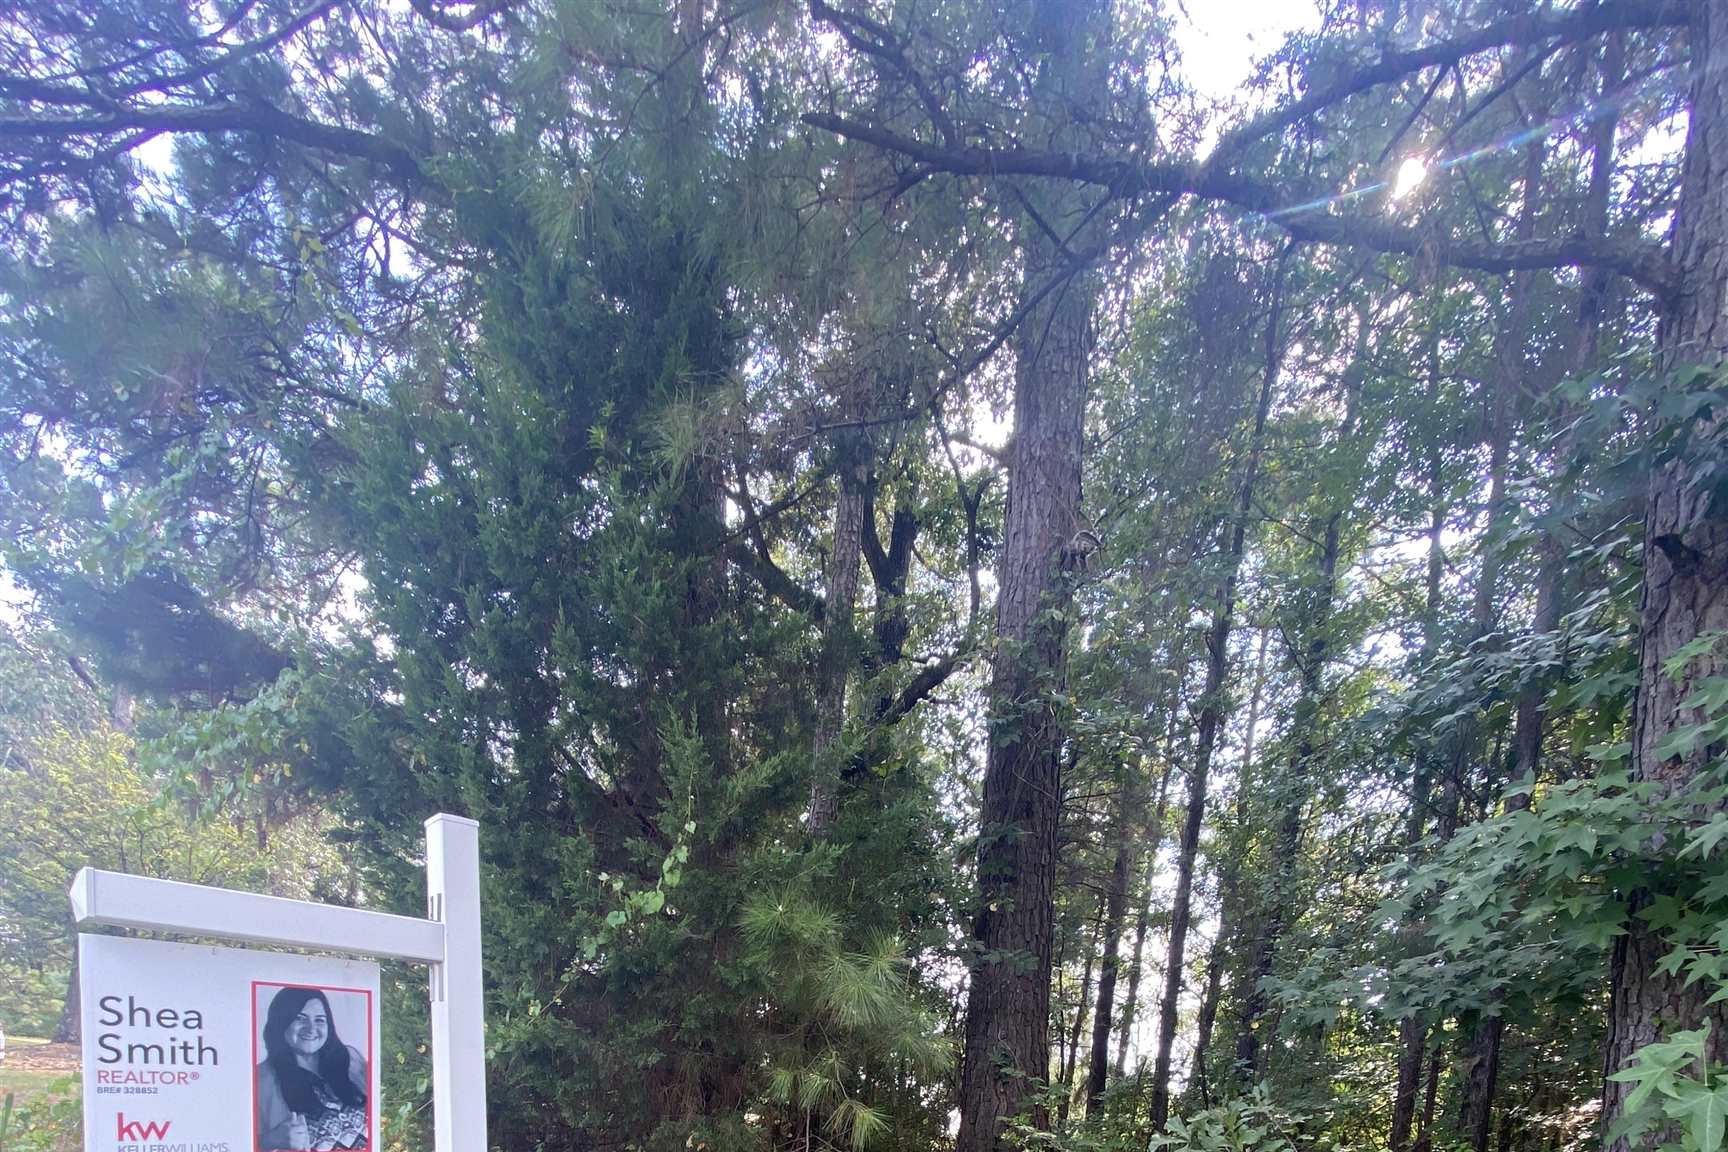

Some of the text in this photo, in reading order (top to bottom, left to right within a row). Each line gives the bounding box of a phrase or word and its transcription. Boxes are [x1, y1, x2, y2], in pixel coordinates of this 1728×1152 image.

[99, 995, 203, 1030] Shea
[97, 1033, 219, 1066] Smith
[96, 1086, 121, 1094] BRE#
[117, 1112, 172, 1142] kw
